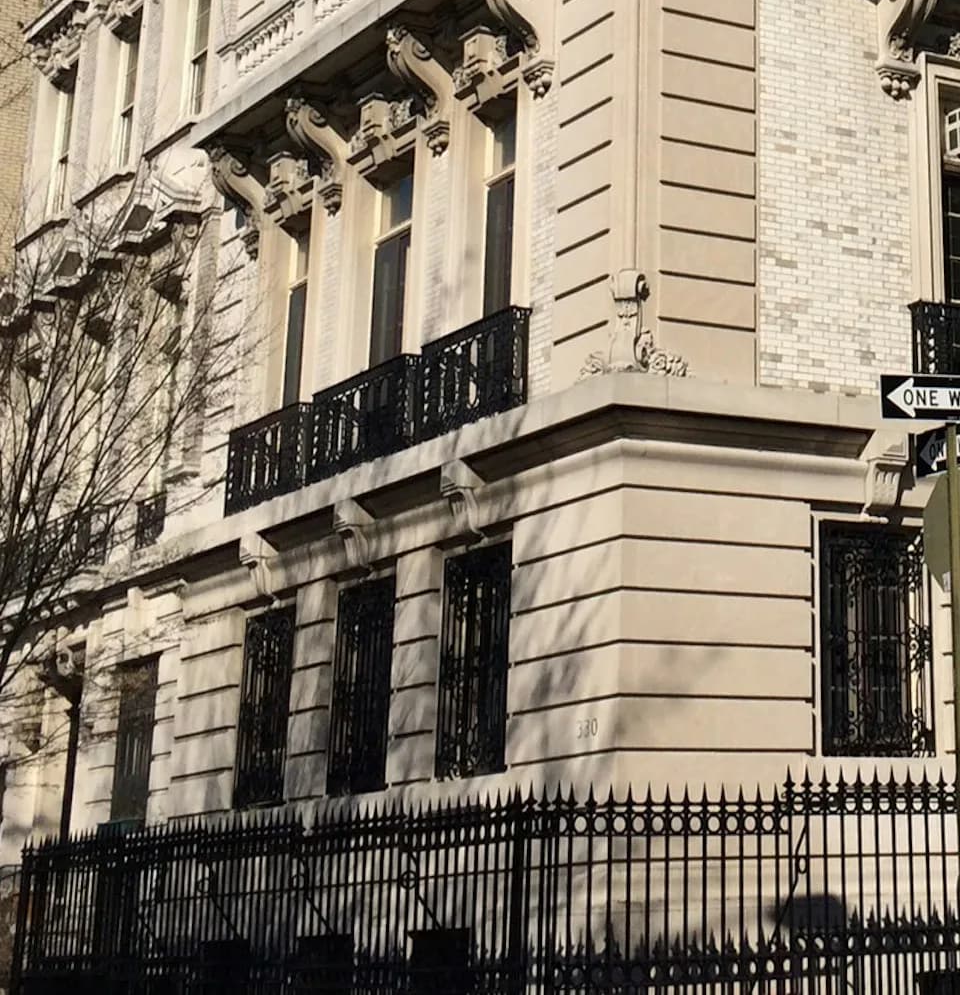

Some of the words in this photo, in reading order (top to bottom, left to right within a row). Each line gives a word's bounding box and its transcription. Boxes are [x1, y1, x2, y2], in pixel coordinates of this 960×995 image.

[903, 389, 938, 406] ONE
[929, 441, 945, 461] ON
[577, 718, 598, 739] 330
